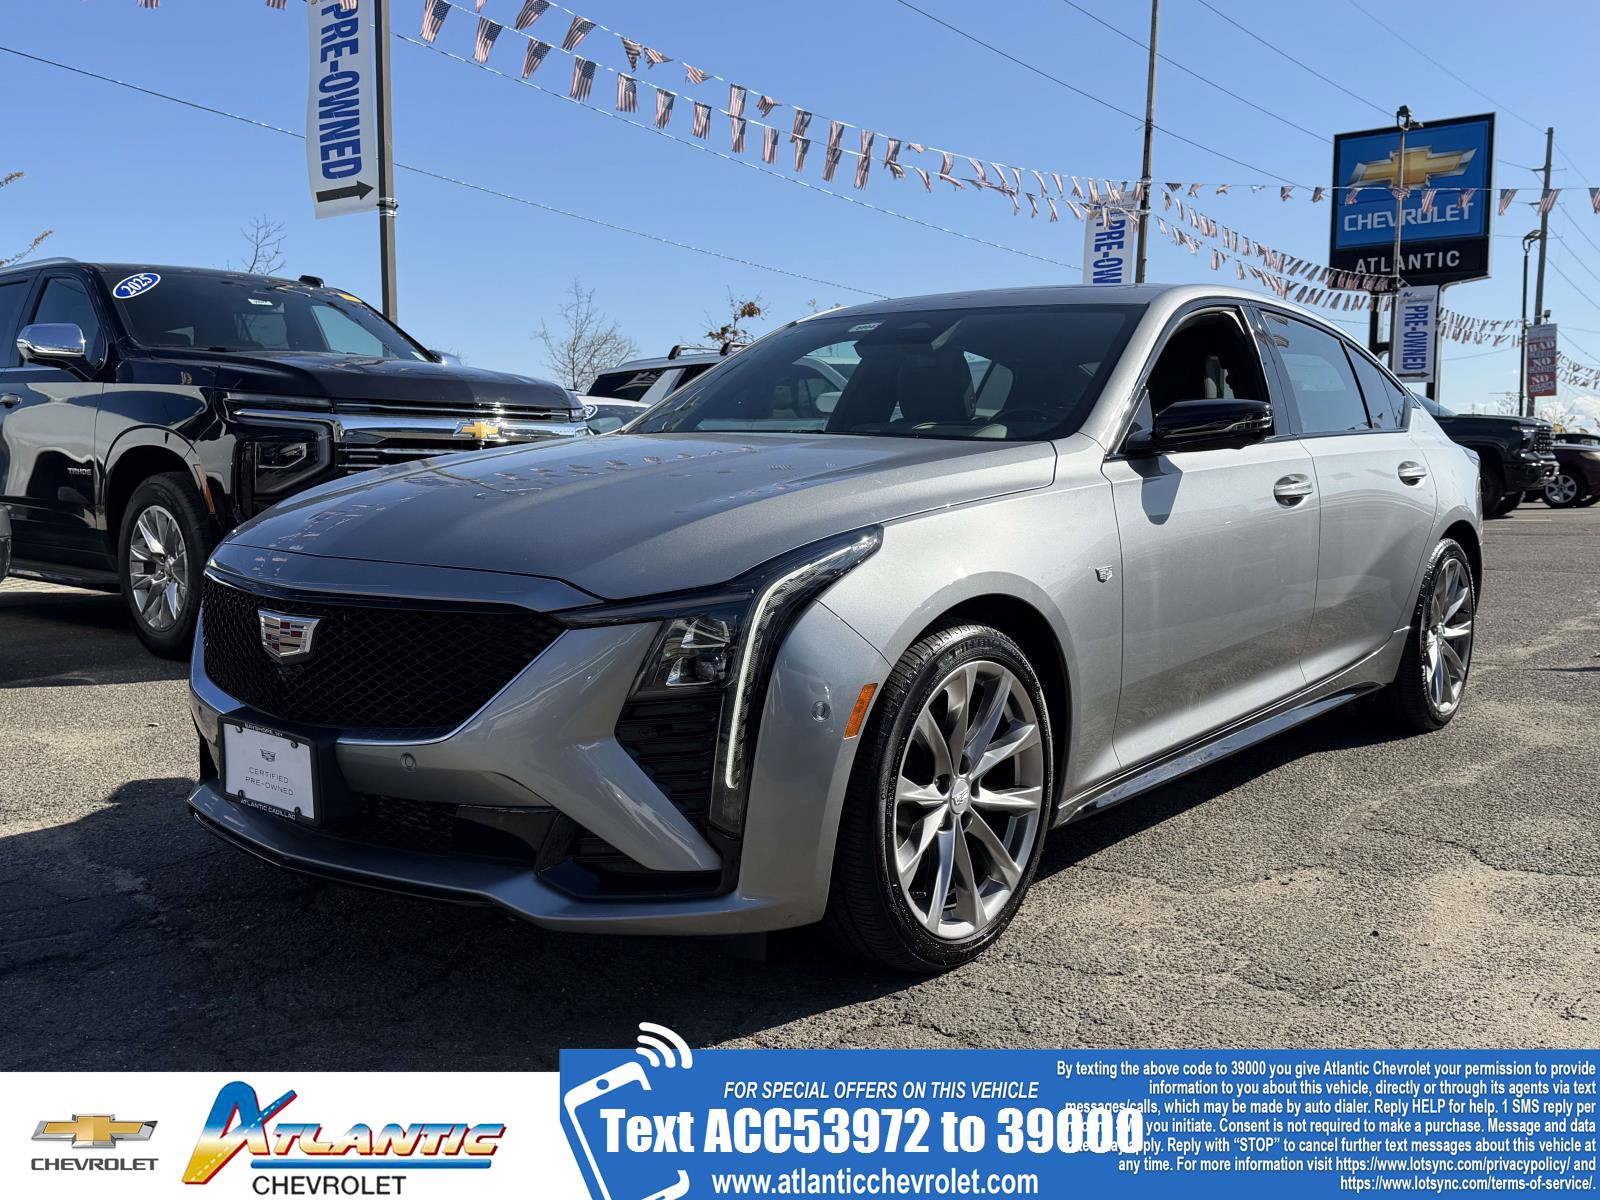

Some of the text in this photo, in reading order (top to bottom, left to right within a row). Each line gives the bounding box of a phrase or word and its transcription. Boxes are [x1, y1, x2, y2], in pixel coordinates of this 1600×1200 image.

[318, 0, 362, 180] PRE-OWNED
[1343, 202, 1475, 232] CHEVROLET
[1092, 219, 1126, 284] PRE-OW
[1354, 250, 1460, 274] ATLANTIC
[121, 273, 154, 296] 2025
[1402, 305, 1429, 370] PRE-OWNED
[67, 467, 93, 476] TAHOE
[245, 776, 294, 796] PRE-OWNED
[248, 766, 289, 784] CERTIFIED
[240, 799, 296, 820] ATLANTIC CADILLAC
